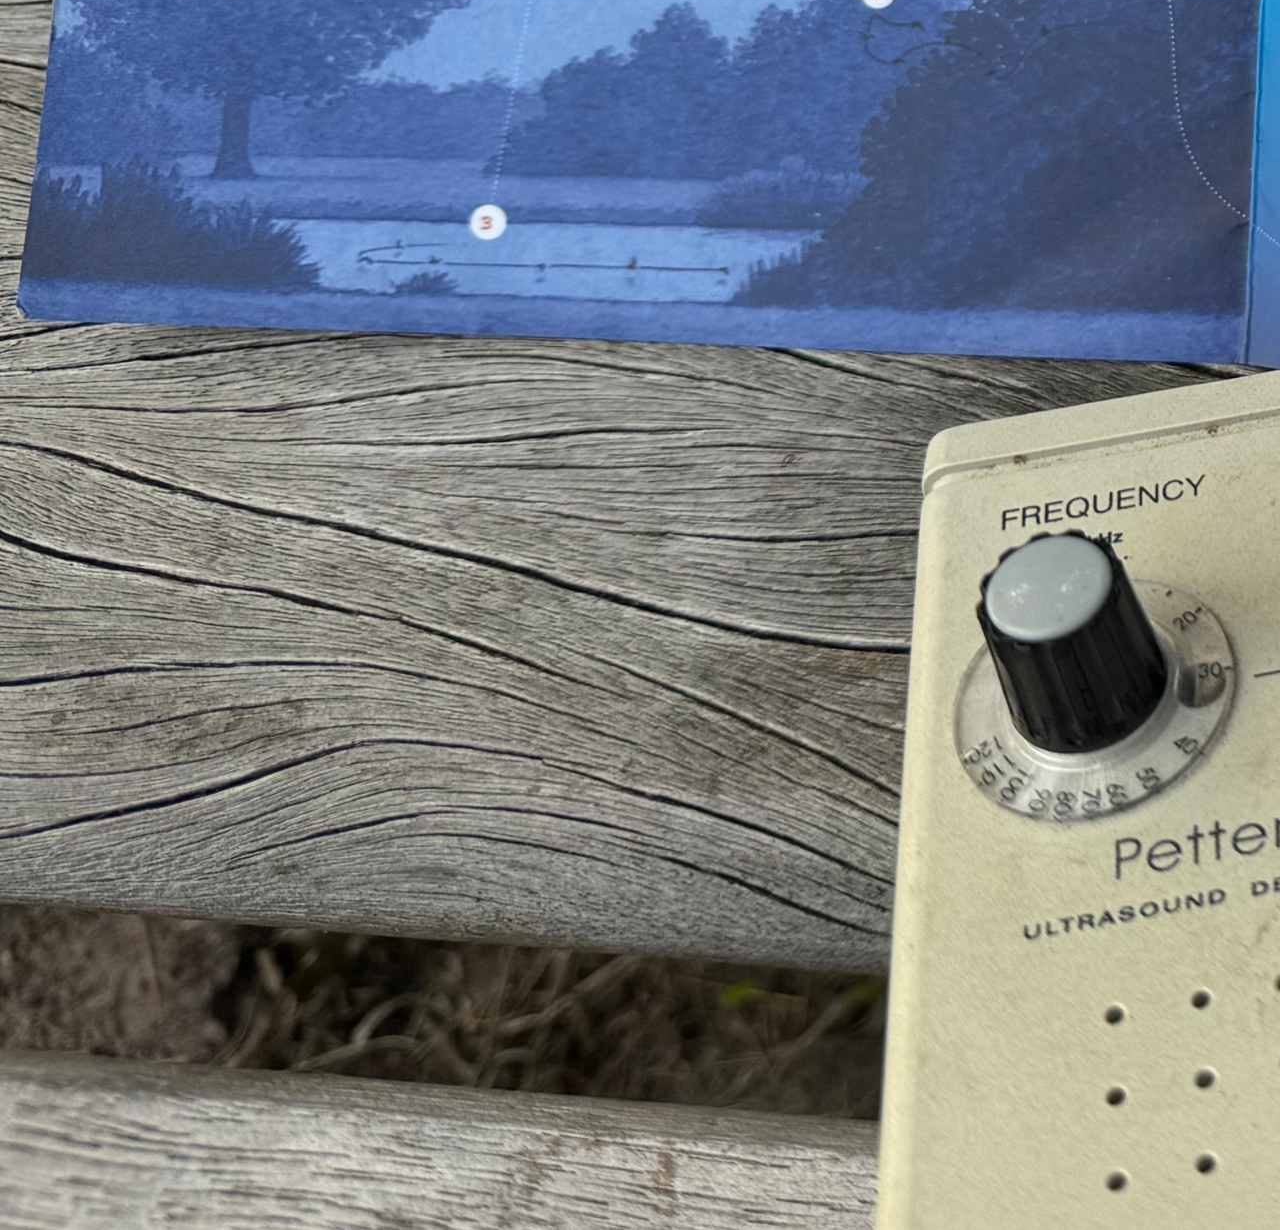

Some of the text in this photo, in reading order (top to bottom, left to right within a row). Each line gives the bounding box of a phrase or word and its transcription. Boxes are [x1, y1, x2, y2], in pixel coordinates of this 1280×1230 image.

[480, 216, 492, 230] 3
[1002, 475, 1205, 532] FREQUENCY
[1023, 889, 1226, 940] ULTRASOUND
